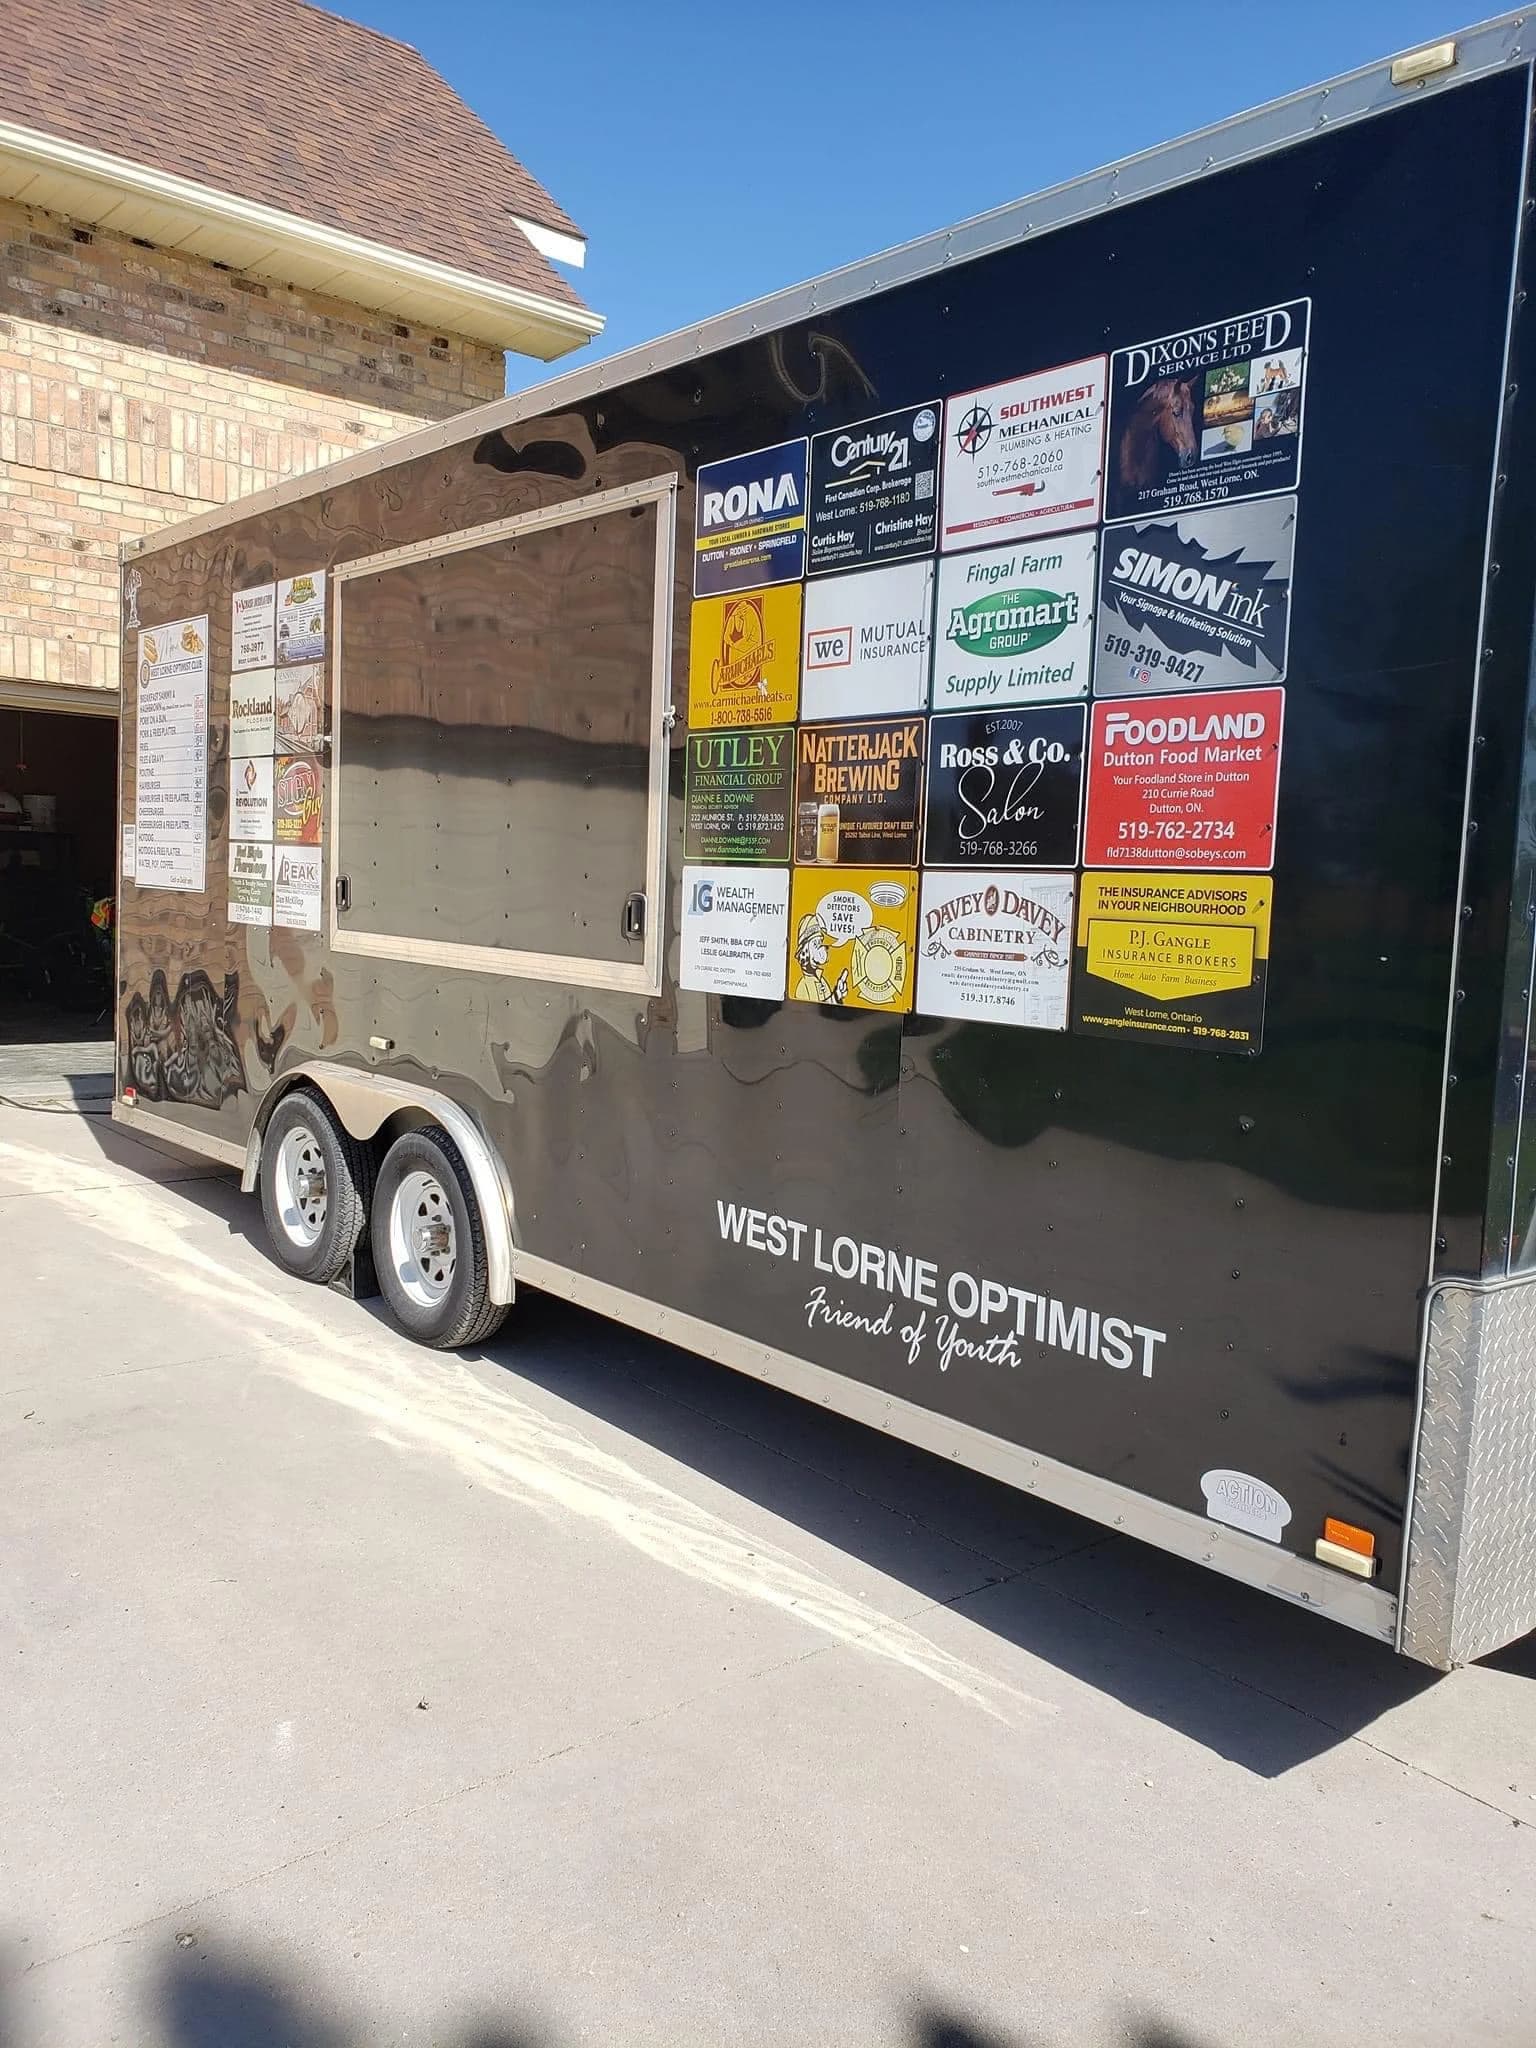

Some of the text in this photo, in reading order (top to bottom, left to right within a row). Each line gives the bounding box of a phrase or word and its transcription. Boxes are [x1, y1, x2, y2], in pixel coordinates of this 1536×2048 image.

[1125, 310, 1291, 387] DIXON'S FEED
[1159, 343, 1251, 377] SERVICE LTD
[1000, 384, 1095, 419] SOUTHWEST
[1000, 407, 1094, 438] MECHANICAL
[831, 431, 896, 467] Century
[1001, 424, 1092, 453] PLUMBING & HEATING
[978, 449, 1063, 479] 519-768-2060
[977, 464, 1063, 488] southwestmechanical.ca
[1138, 491, 1149, 500] 217
[1151, 483, 1177, 497] Graham
[1179, 479, 1198, 492] Road,
[1201, 478, 1217, 487] West
[1219, 473, 1242, 485] Lorne,
[704, 473, 799, 526] RONA
[825, 477, 912, 503] First Canadian Corp. Brokerage
[1163, 486, 1228, 508] 519.768.1570
[816, 511, 833, 522] West
[860, 492, 910, 512] 519-768-1180
[709, 537, 718, 545] YOUR
[732, 532, 747, 540] LUMBER
[752, 525, 773, 536] HARDWARE
[775, 522, 790, 532] STORES
[876, 514, 933, 534] Christine Hay
[702, 535, 796, 562] DUTTON RODNEY SPRINGFIELD
[812, 531, 854, 547] Curtis Hay
[967, 554, 1062, 584] Fingal Farm
[1001, 593, 1020, 605] THE
[947, 592, 1079, 641] Agromart
[1119, 591, 1252, 648] Your Signage & Marketing Solution
[861, 620, 925, 643] MUTUAL
[990, 633, 1028, 649] GROUP
[815, 639, 843, 658] we
[860, 641, 924, 660] INSURANCE
[1104, 634, 1204, 683] 519-319-9427
[946, 662, 1074, 696] Supply Limited
[232, 696, 272, 719] Rockland
[1105, 712, 1265, 746] FOODLAND
[695, 736, 784, 768] UTLEY
[803, 726, 918, 763] NATTERJACK
[1003, 739, 1025, 765] &
[1104, 745, 1262, 767] Dutton Food Market
[695, 773, 783, 786] FINANCIAL GROUP
[815, 760, 900, 793] BREWING
[1113, 772, 1249, 785] Your Foodland Store in Dutton
[236, 798, 267, 807] REVOLUTION
[692, 794, 715, 803] DIANNE
[724, 794, 754, 802] DOWNIE
[824, 793, 886, 804] COMPANY LTD.
[959, 760, 1044, 839] Salon
[1143, 788, 1214, 799] 210 Currie Road
[1150, 803, 1204, 814] Dutton, ON.
[1118, 821, 1235, 839] 519-762-2734
[960, 841, 1037, 855] 519-768-3266
[1107, 847, 1246, 861] fld7138dutton@sobeys.com
[283, 859, 314, 880] PEAK
[693, 884, 713, 912] IG
[717, 887, 754, 899] WEALTH
[834, 895, 855, 903] SMOKE
[1099, 887, 1247, 901] THE INSURANCE ADVISORS
[717, 901, 784, 915] MANAGEMENT
[827, 904, 860, 912] DETECTORS
[832, 912, 854, 922] SAVE
[926, 890, 1066, 945] DAVEY DAVEY
[1099, 900, 1245, 915] IN YOUR NEIGHBOURHOOD
[830, 922, 855, 934] LIVES!
[949, 927, 1036, 944] CABINETRY
[711, 937, 729, 946] SMITH,
[744, 939, 754, 947] CFP
[701, 948, 764, 960] LESLIE GALBRAITH, CFP
[1102, 949, 1237, 967] INSURANCE BROKERS
[1114, 969, 1217, 986] Home Auto Farm Business
[961, 993, 1015, 1005] 519.317.8746
[1124, 1007, 1202, 1023] West Lorne, Ontario
[1083, 1015, 1249, 1040] www.gangleinsurance.com 519-768-2831
[716, 1201, 1167, 1378] WEST LORNE OPTIMIST
[805, 1287, 1022, 1372] Friend of Youth
[1216, 1480, 1278, 1515] ACTION
